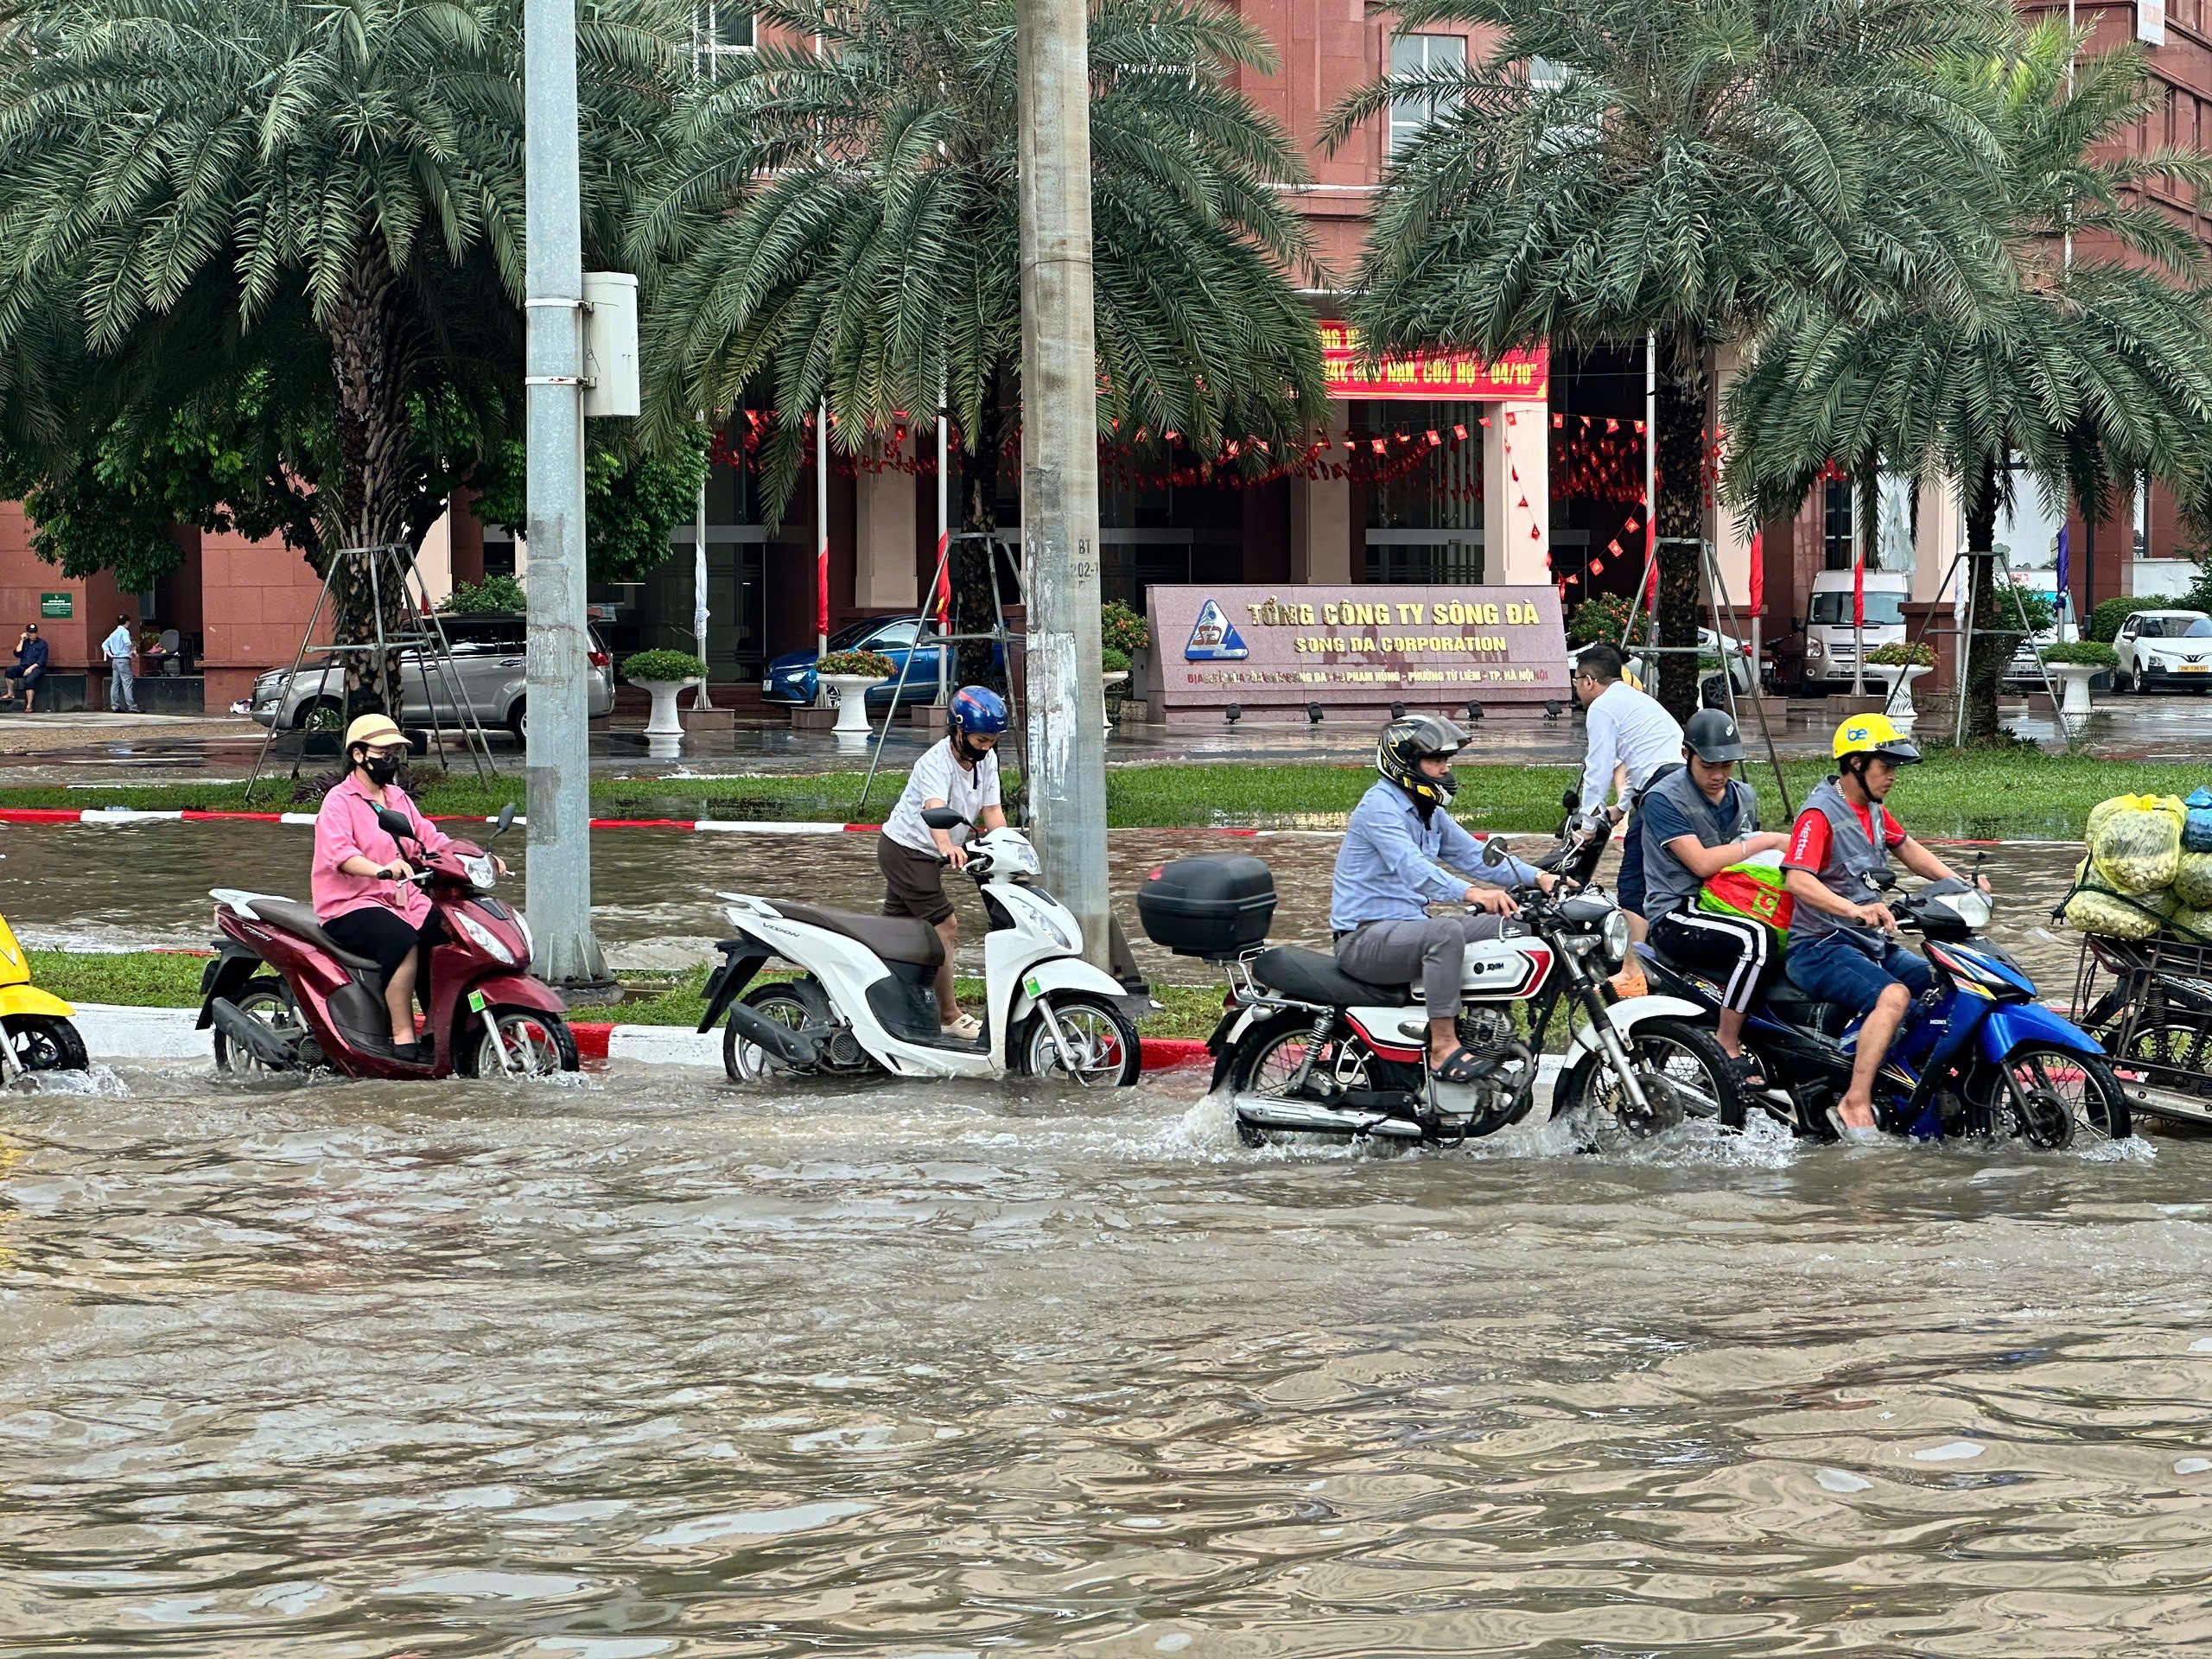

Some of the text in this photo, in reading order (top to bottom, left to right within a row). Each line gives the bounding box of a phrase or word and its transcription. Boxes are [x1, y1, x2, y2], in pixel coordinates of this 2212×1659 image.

[1247, 595, 1540, 625] TỔNG CÔNG TY SÔNG ĐÀ
[1295, 636, 1507, 652] SONG DA CORPORATION
[1847, 728, 1867, 741] be
[1793, 819, 1813, 861] viettel
